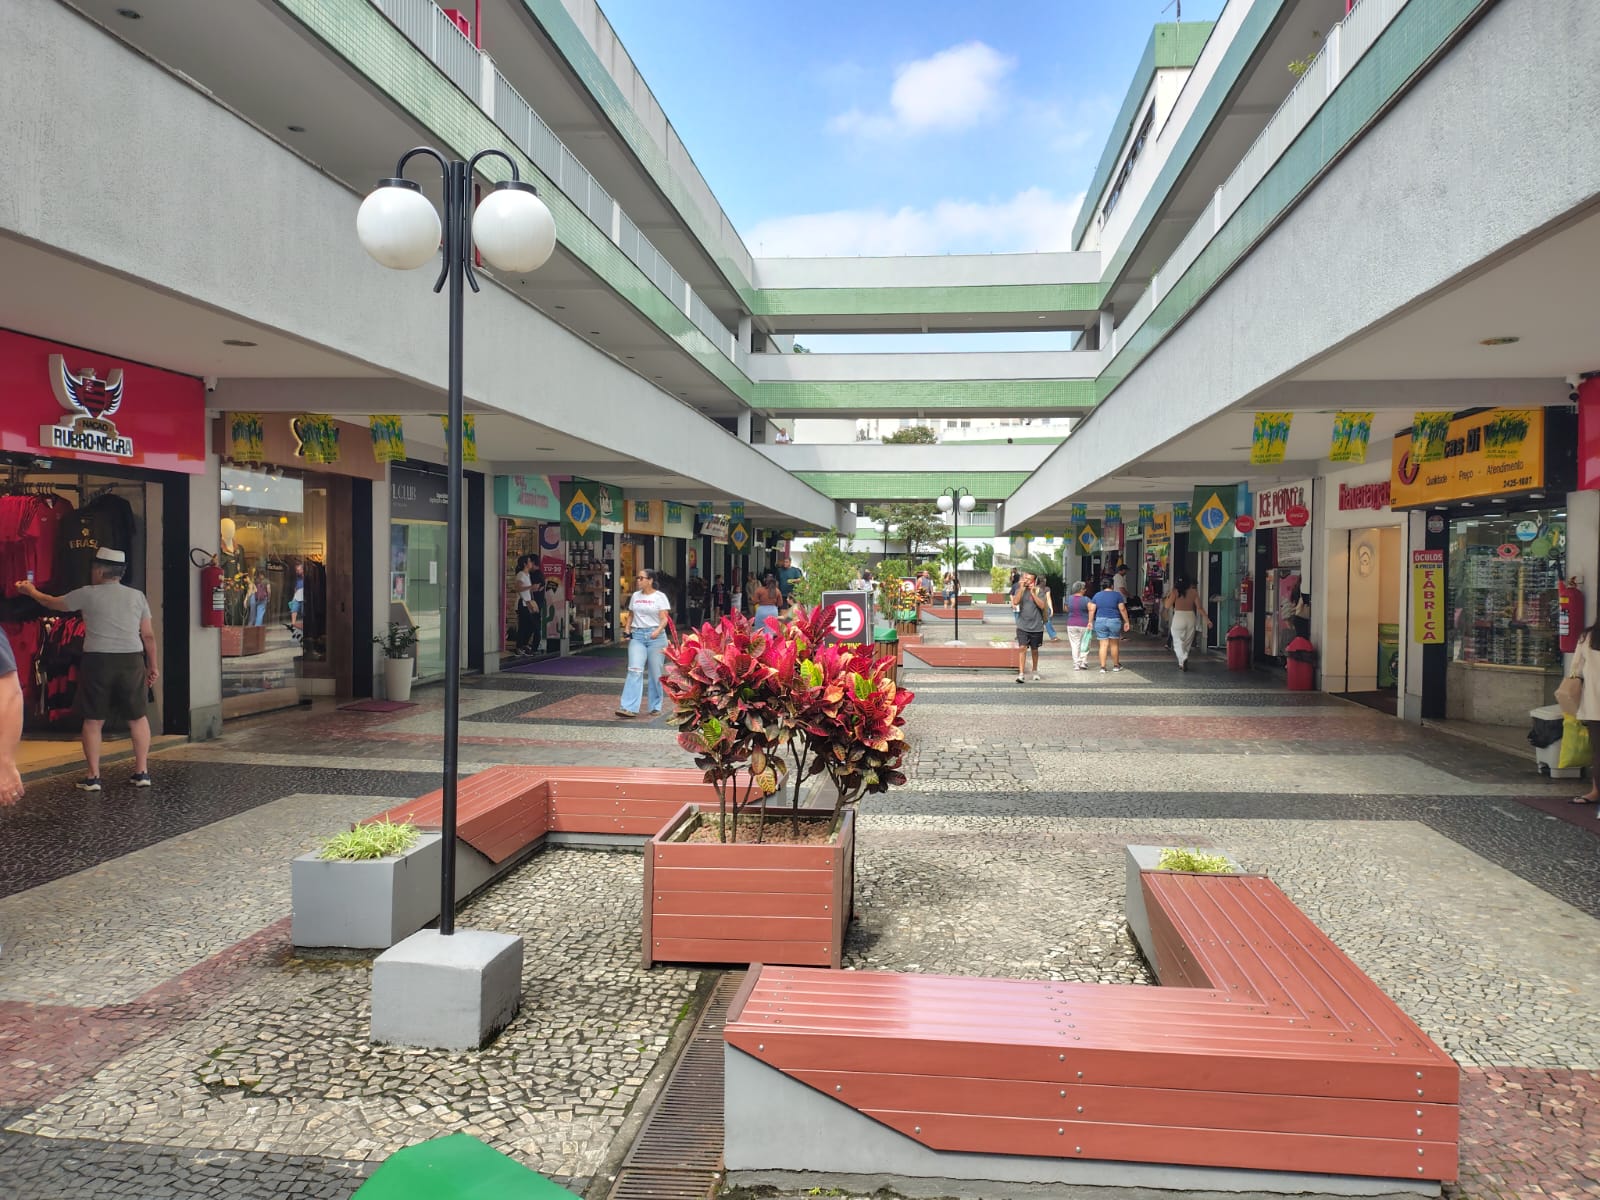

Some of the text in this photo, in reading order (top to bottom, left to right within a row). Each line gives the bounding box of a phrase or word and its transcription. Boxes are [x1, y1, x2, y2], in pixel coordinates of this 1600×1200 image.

[54, 428, 133, 455] RUBRO-NEGRA
[1259, 490, 1272, 518] ICE
[837, 608, 853, 632] E
